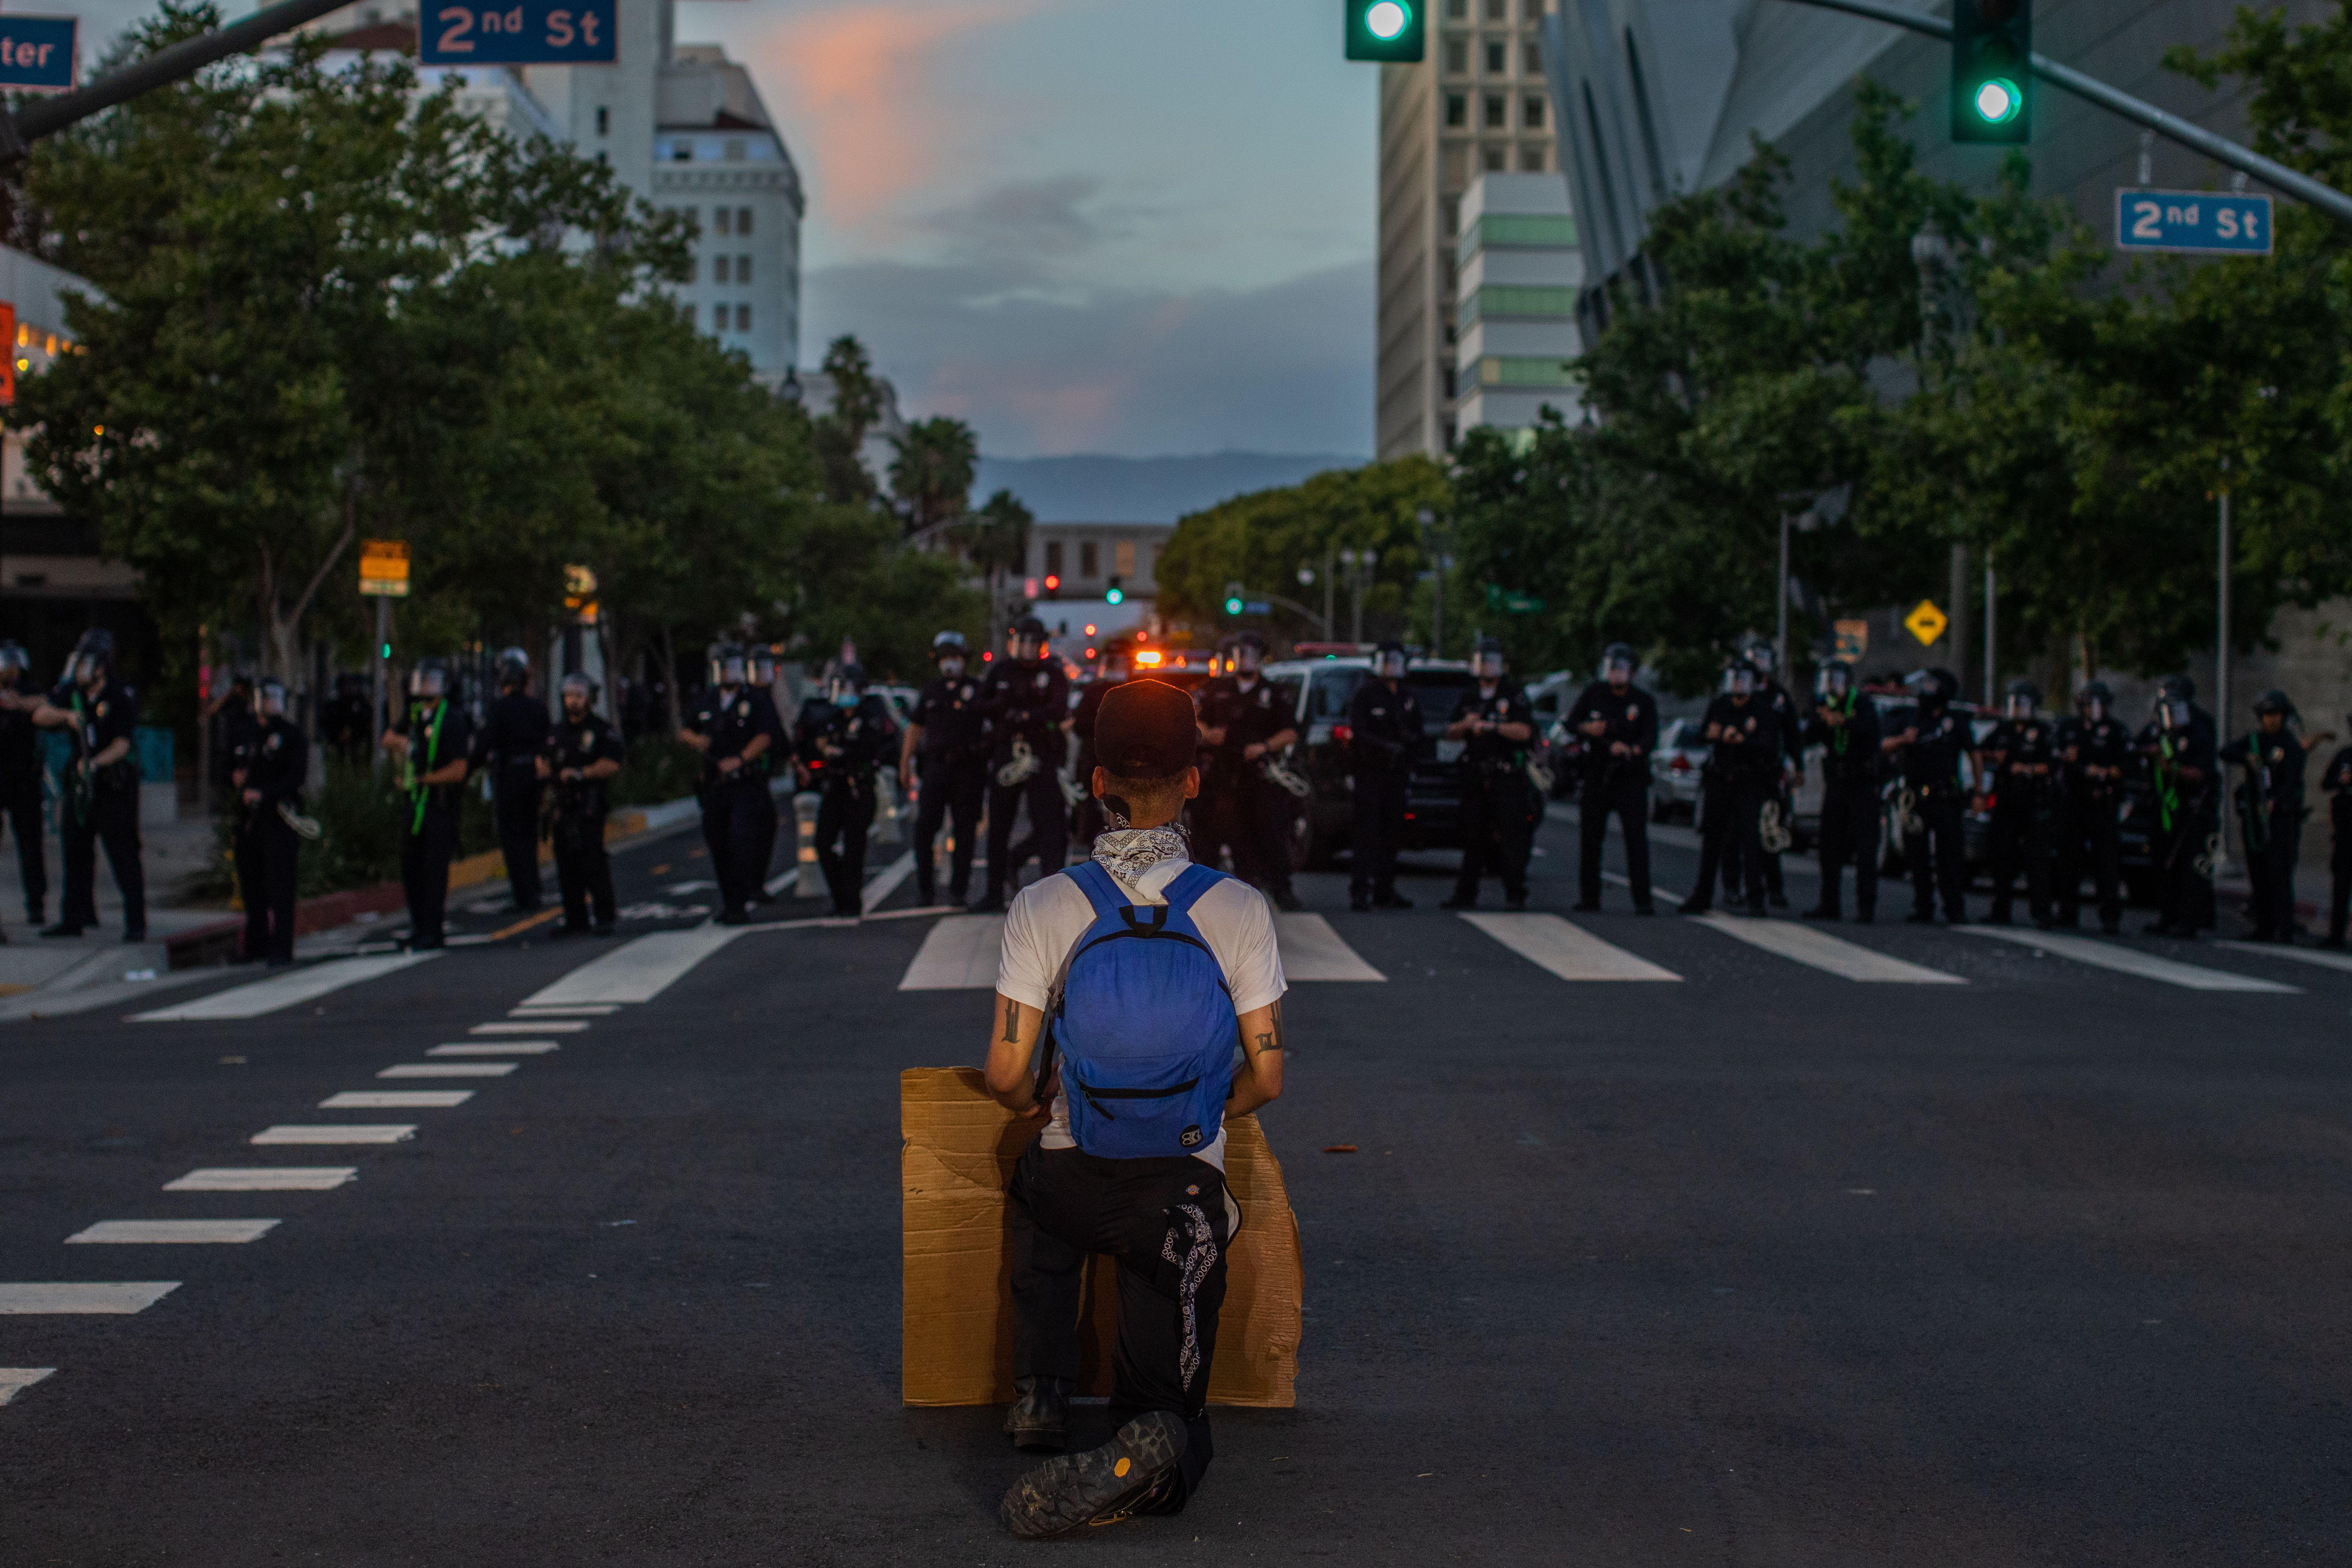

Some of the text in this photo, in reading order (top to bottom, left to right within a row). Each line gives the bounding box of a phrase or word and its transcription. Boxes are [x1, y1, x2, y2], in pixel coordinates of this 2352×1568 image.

[437, 6, 599, 52] 2nd St
[0, 37, 54, 67] ter
[2132, 201, 2258, 239] 2nd St
